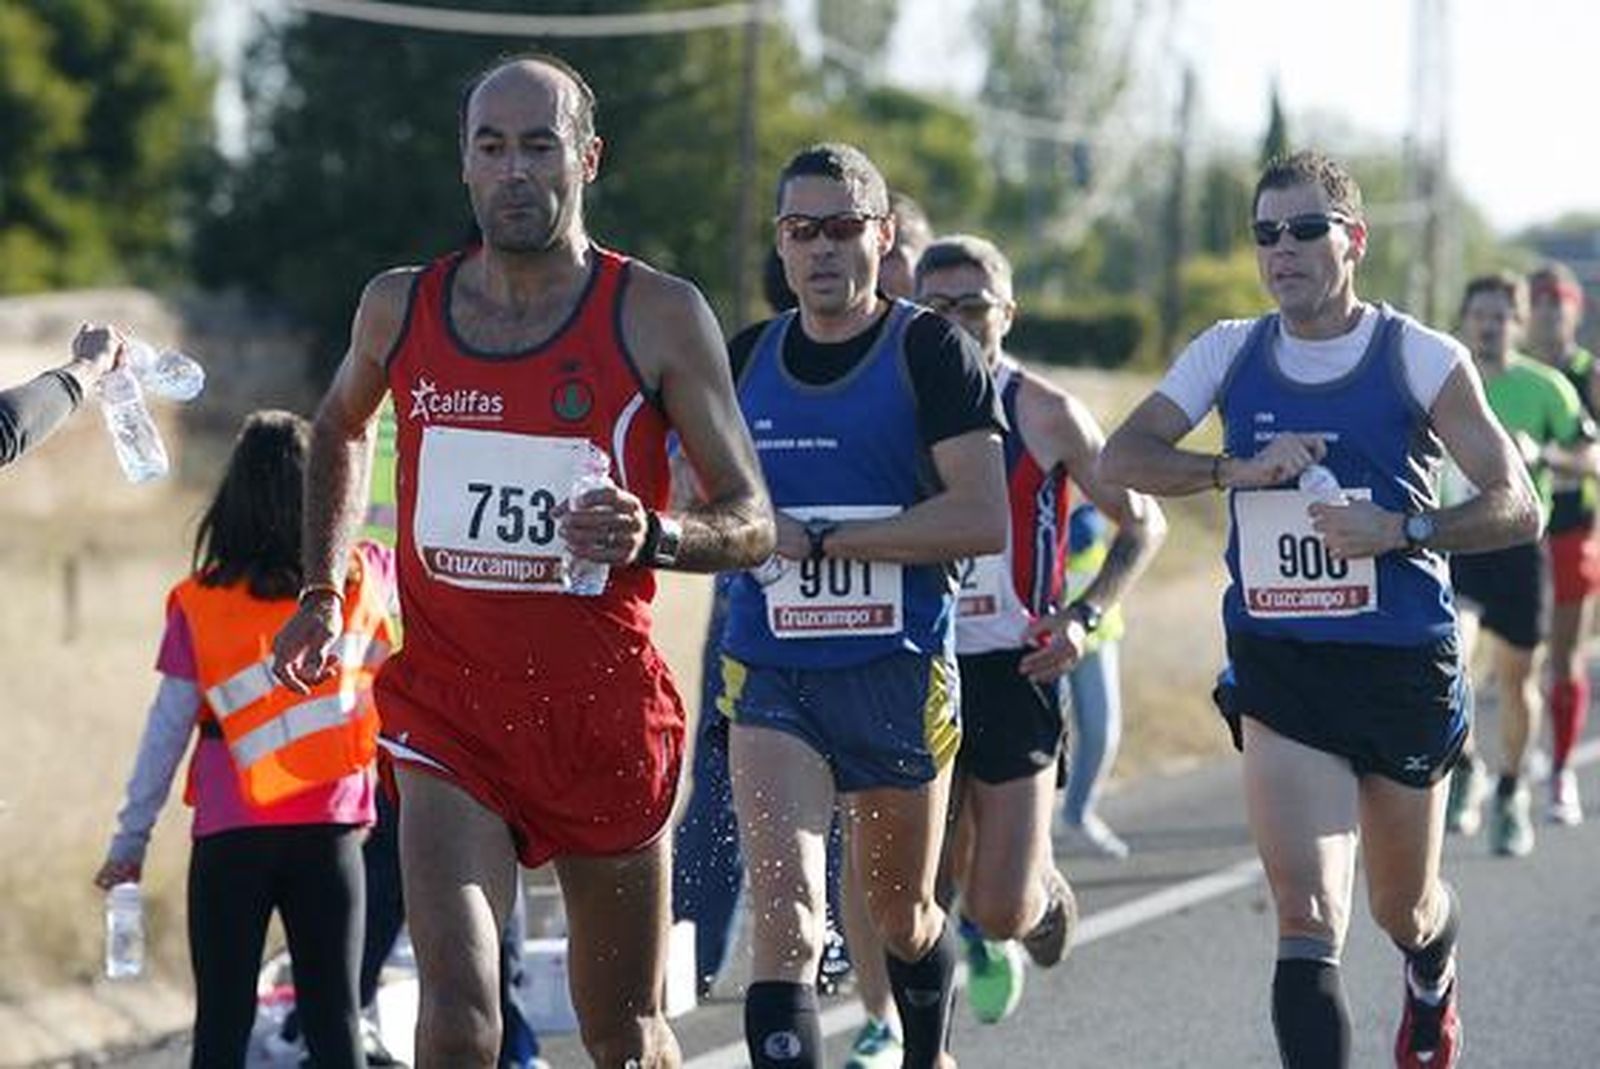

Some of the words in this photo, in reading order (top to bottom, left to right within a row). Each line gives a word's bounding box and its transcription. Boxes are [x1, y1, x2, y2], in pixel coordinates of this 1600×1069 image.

[429, 390, 504, 413] califas
[467, 482, 556, 546] 753
[435, 551, 546, 579] Cruzcampo
[800, 556, 871, 598] 901
[1256, 590, 1345, 607] Cruzcampo
